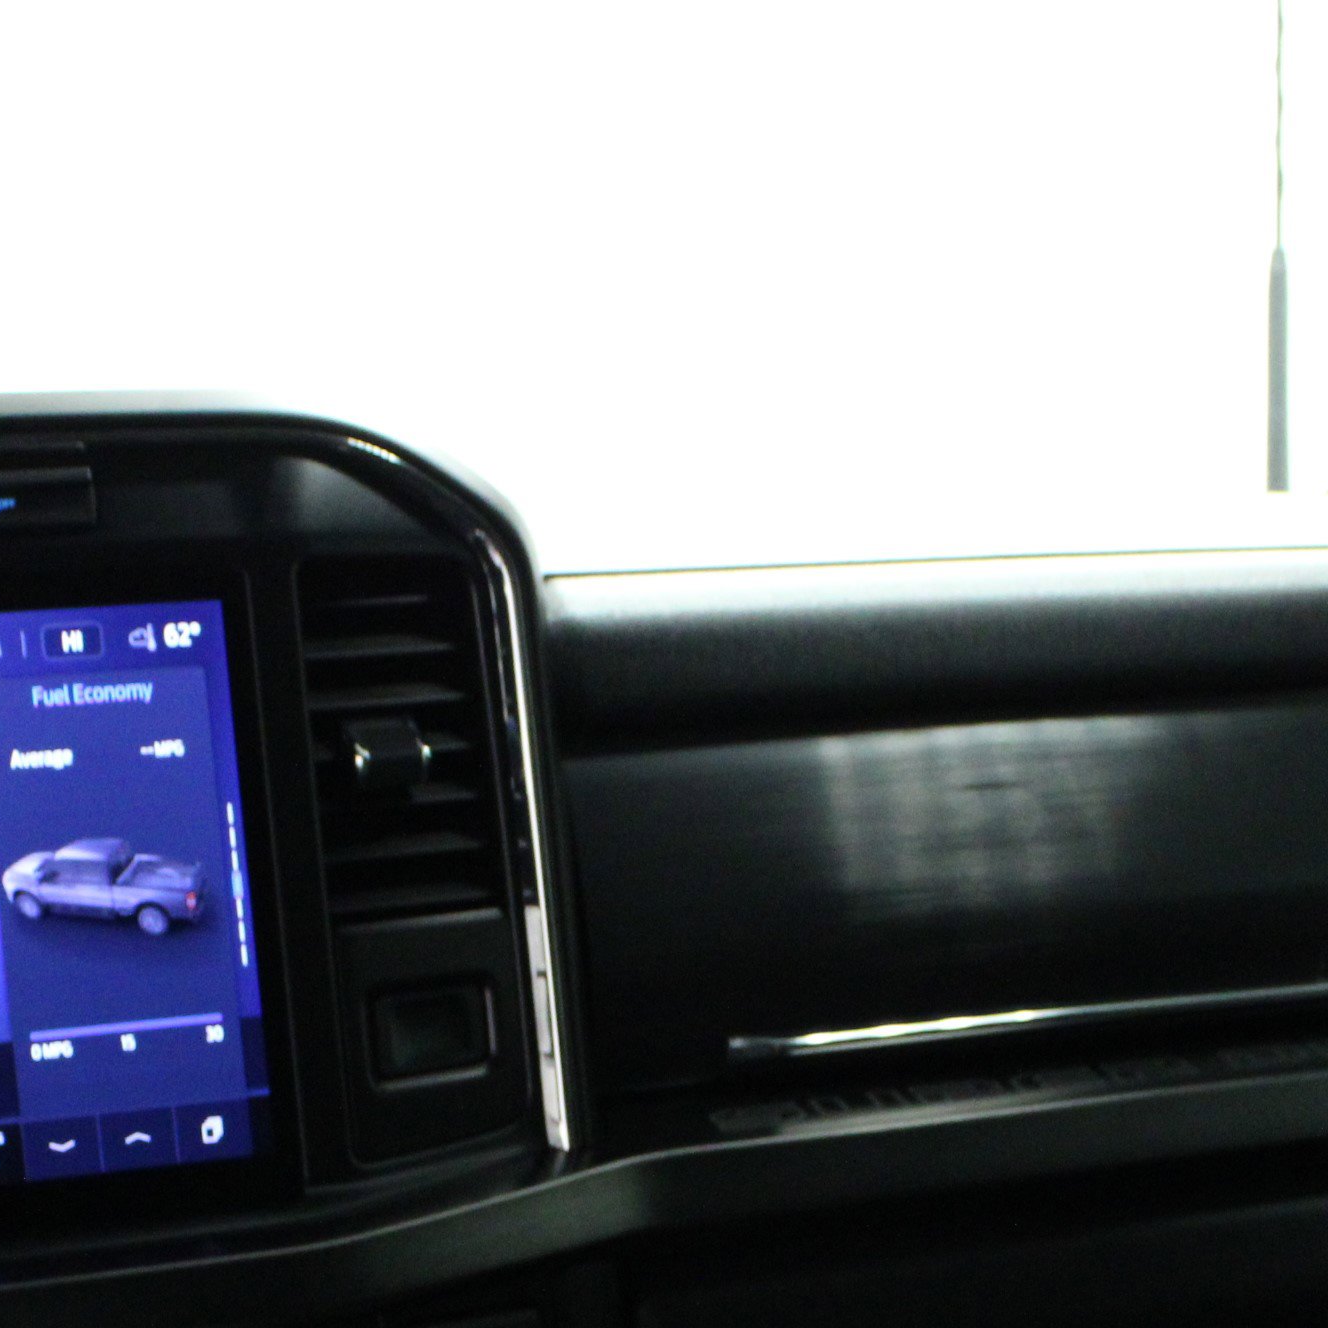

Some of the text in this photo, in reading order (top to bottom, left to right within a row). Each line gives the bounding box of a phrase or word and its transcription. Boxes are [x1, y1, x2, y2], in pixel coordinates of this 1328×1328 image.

[62, 628, 83, 653] HI
[32, 680, 153, 707] Fuel Economy
[11, 748, 73, 770] Average
